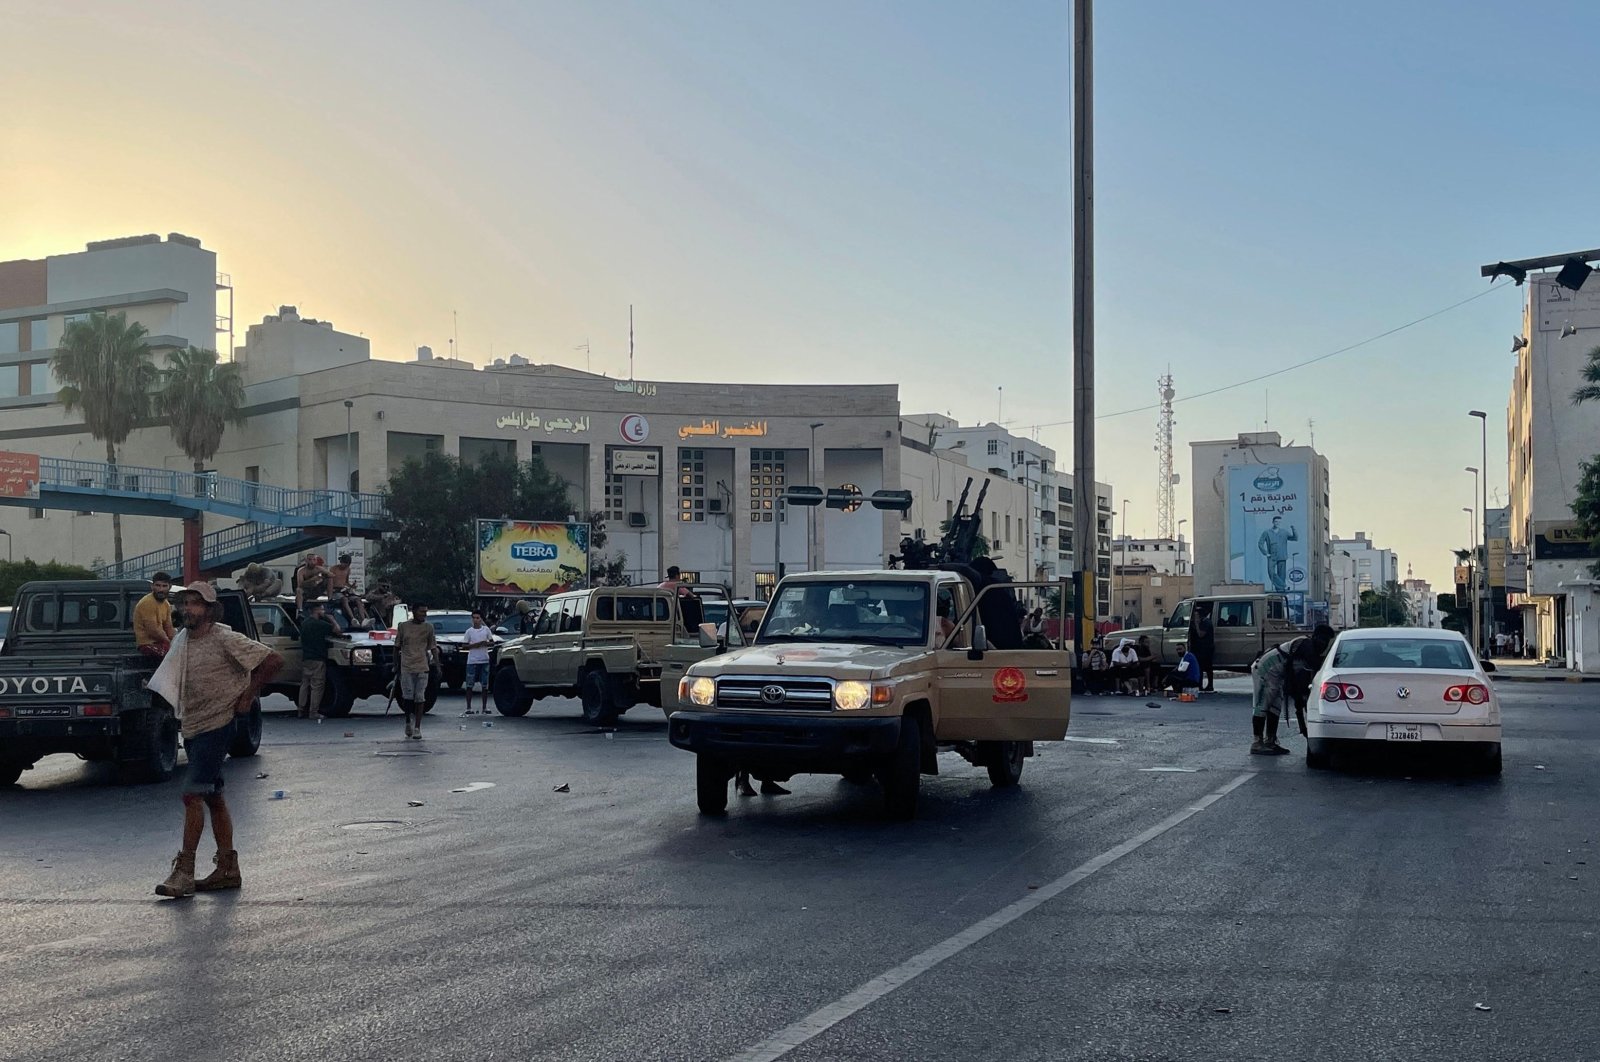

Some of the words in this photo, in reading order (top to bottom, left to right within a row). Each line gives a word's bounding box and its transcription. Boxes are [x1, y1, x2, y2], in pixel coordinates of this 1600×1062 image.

[496, 410, 540, 430] طرابلس
[544, 415, 590, 435] المرجعي
[678, 418, 720, 440] الطبي
[721, 418, 768, 439] المختبر
[1239, 491, 1246, 502] 1
[1250, 493, 1266, 503] رقم
[1267, 493, 1297, 503] المرتبة
[1242, 505, 1275, 515] ليبيا
[1277, 504, 1293, 515] في
[513, 545, 554, 557] TEBRA
